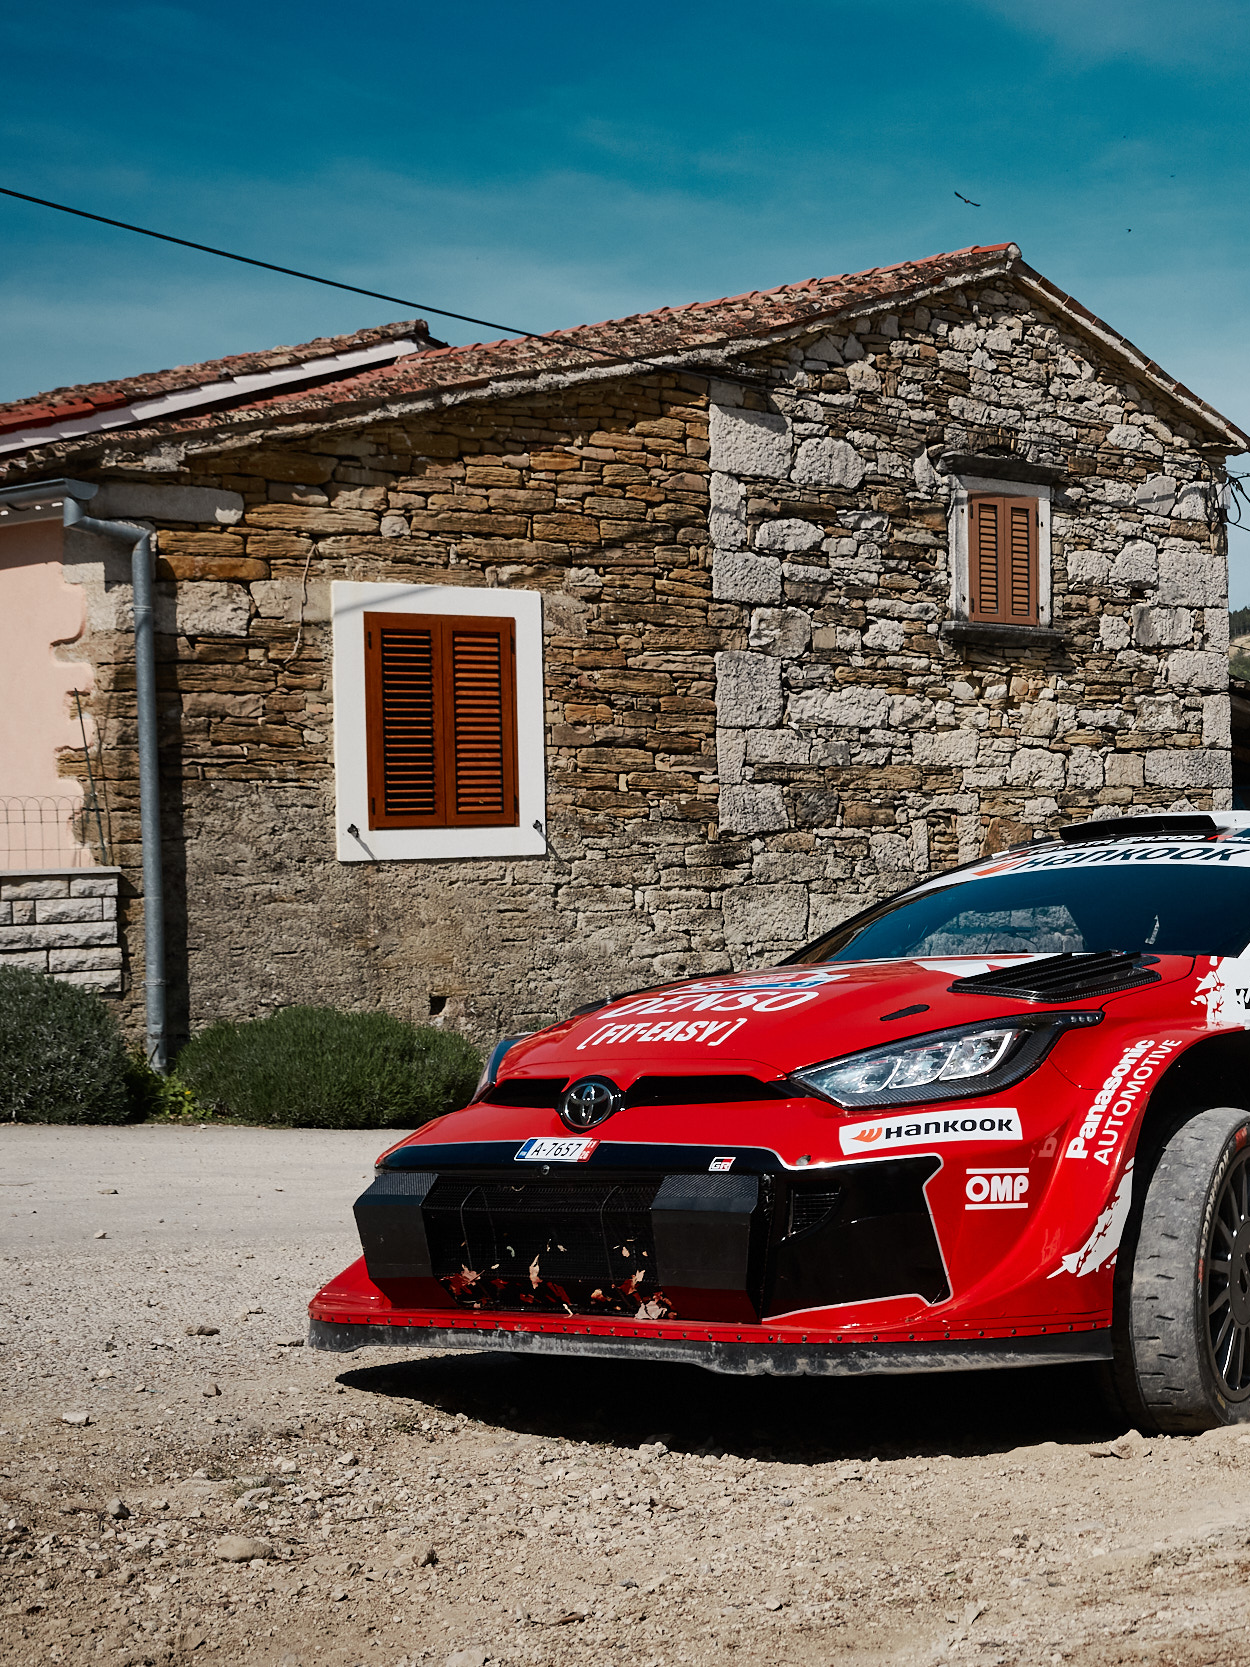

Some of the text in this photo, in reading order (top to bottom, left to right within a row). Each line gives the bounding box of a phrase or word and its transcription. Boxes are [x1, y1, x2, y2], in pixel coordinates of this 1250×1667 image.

[597, 991, 820, 1020] DENSO
[1065, 1039, 1156, 1159] Panasonic
[1093, 1039, 1183, 1166] AUTOMOTIVE
[530, 1141, 582, 1156] A-7657
[965, 1174, 1030, 1202] OMP
